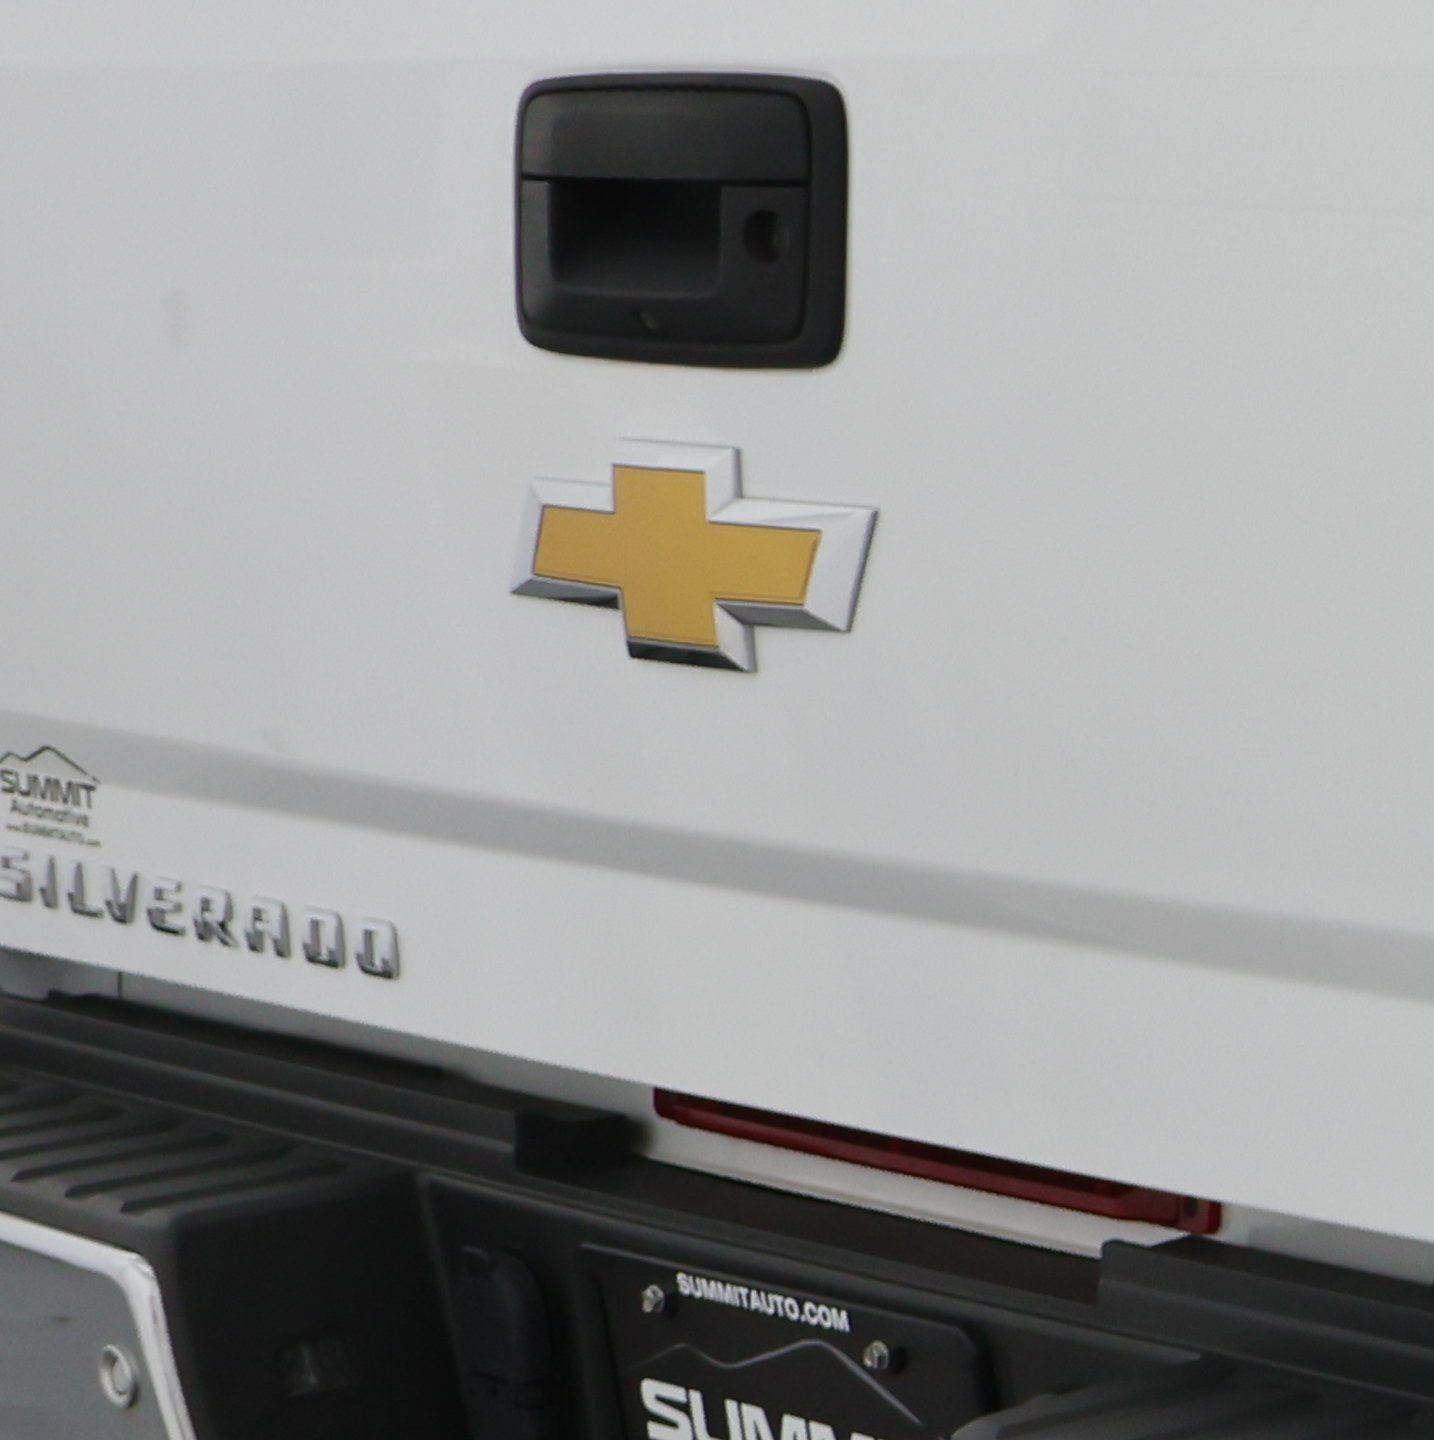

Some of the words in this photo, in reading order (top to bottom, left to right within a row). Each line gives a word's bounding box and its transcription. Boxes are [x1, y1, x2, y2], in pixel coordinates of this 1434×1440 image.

[0, 768, 97, 810] SUMMIT
[0, 846, 401, 980] SILVERADO
[675, 1270, 851, 1333] SUMMITAUTO.COM
